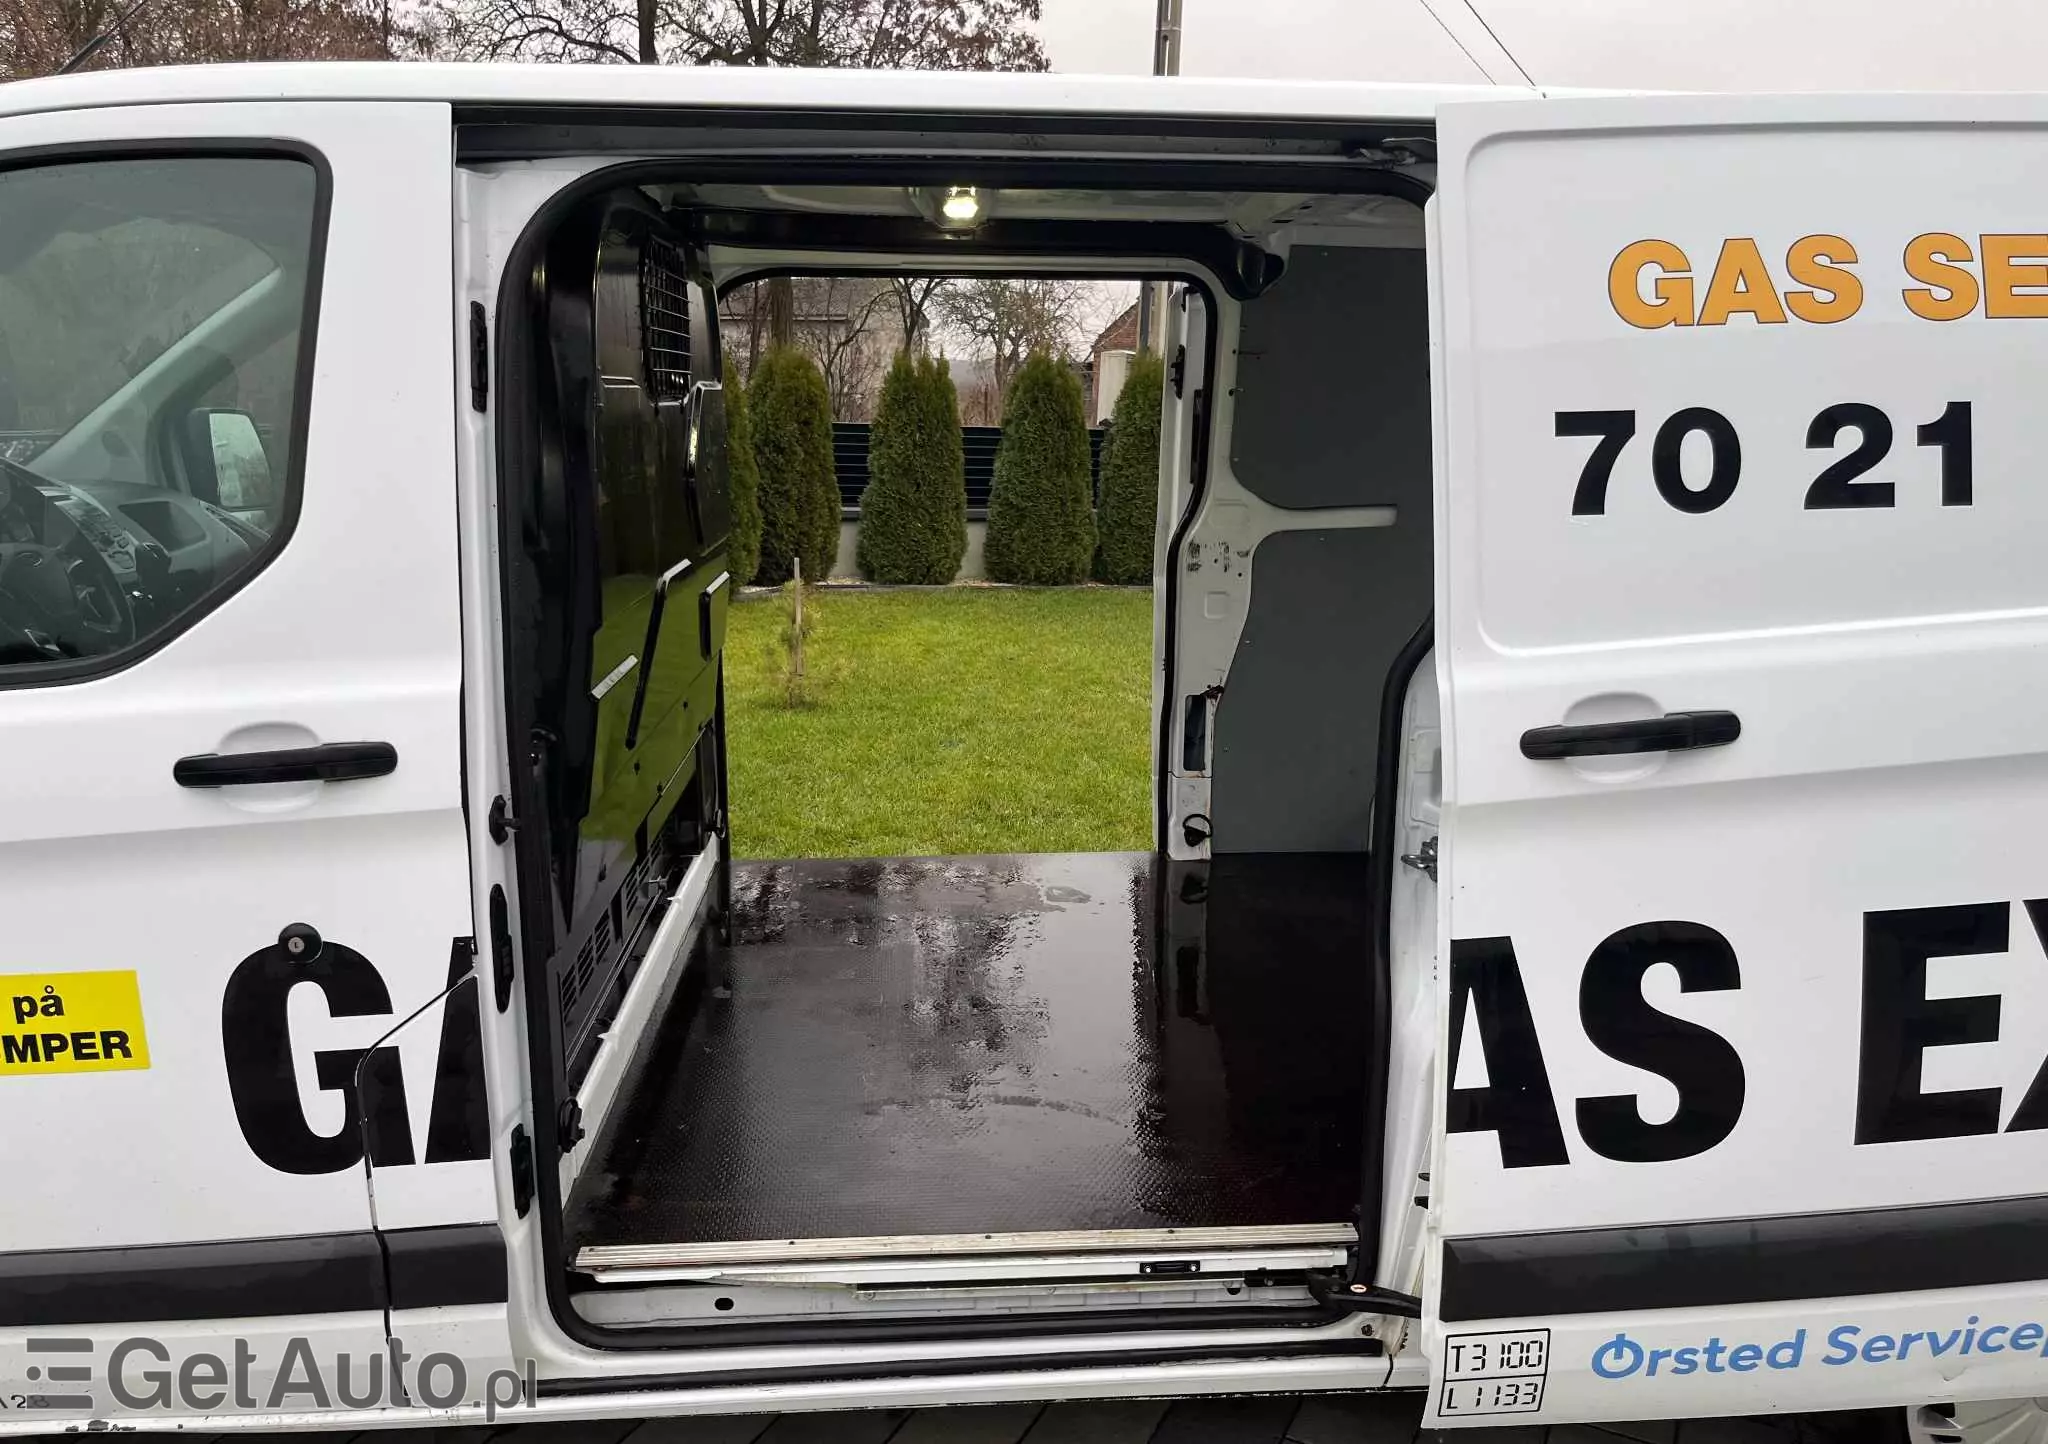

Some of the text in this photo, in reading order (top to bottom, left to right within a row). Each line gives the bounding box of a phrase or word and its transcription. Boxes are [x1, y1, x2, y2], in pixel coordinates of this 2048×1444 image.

[1608, 232, 2048, 329] GAS SE
[1554, 401, 1972, 515] 70 21
[12, 985, 65, 1024] på
[0, 1030, 133, 1063] MPER
[1592, 1315, 2048, 1378] Ørsted Service
